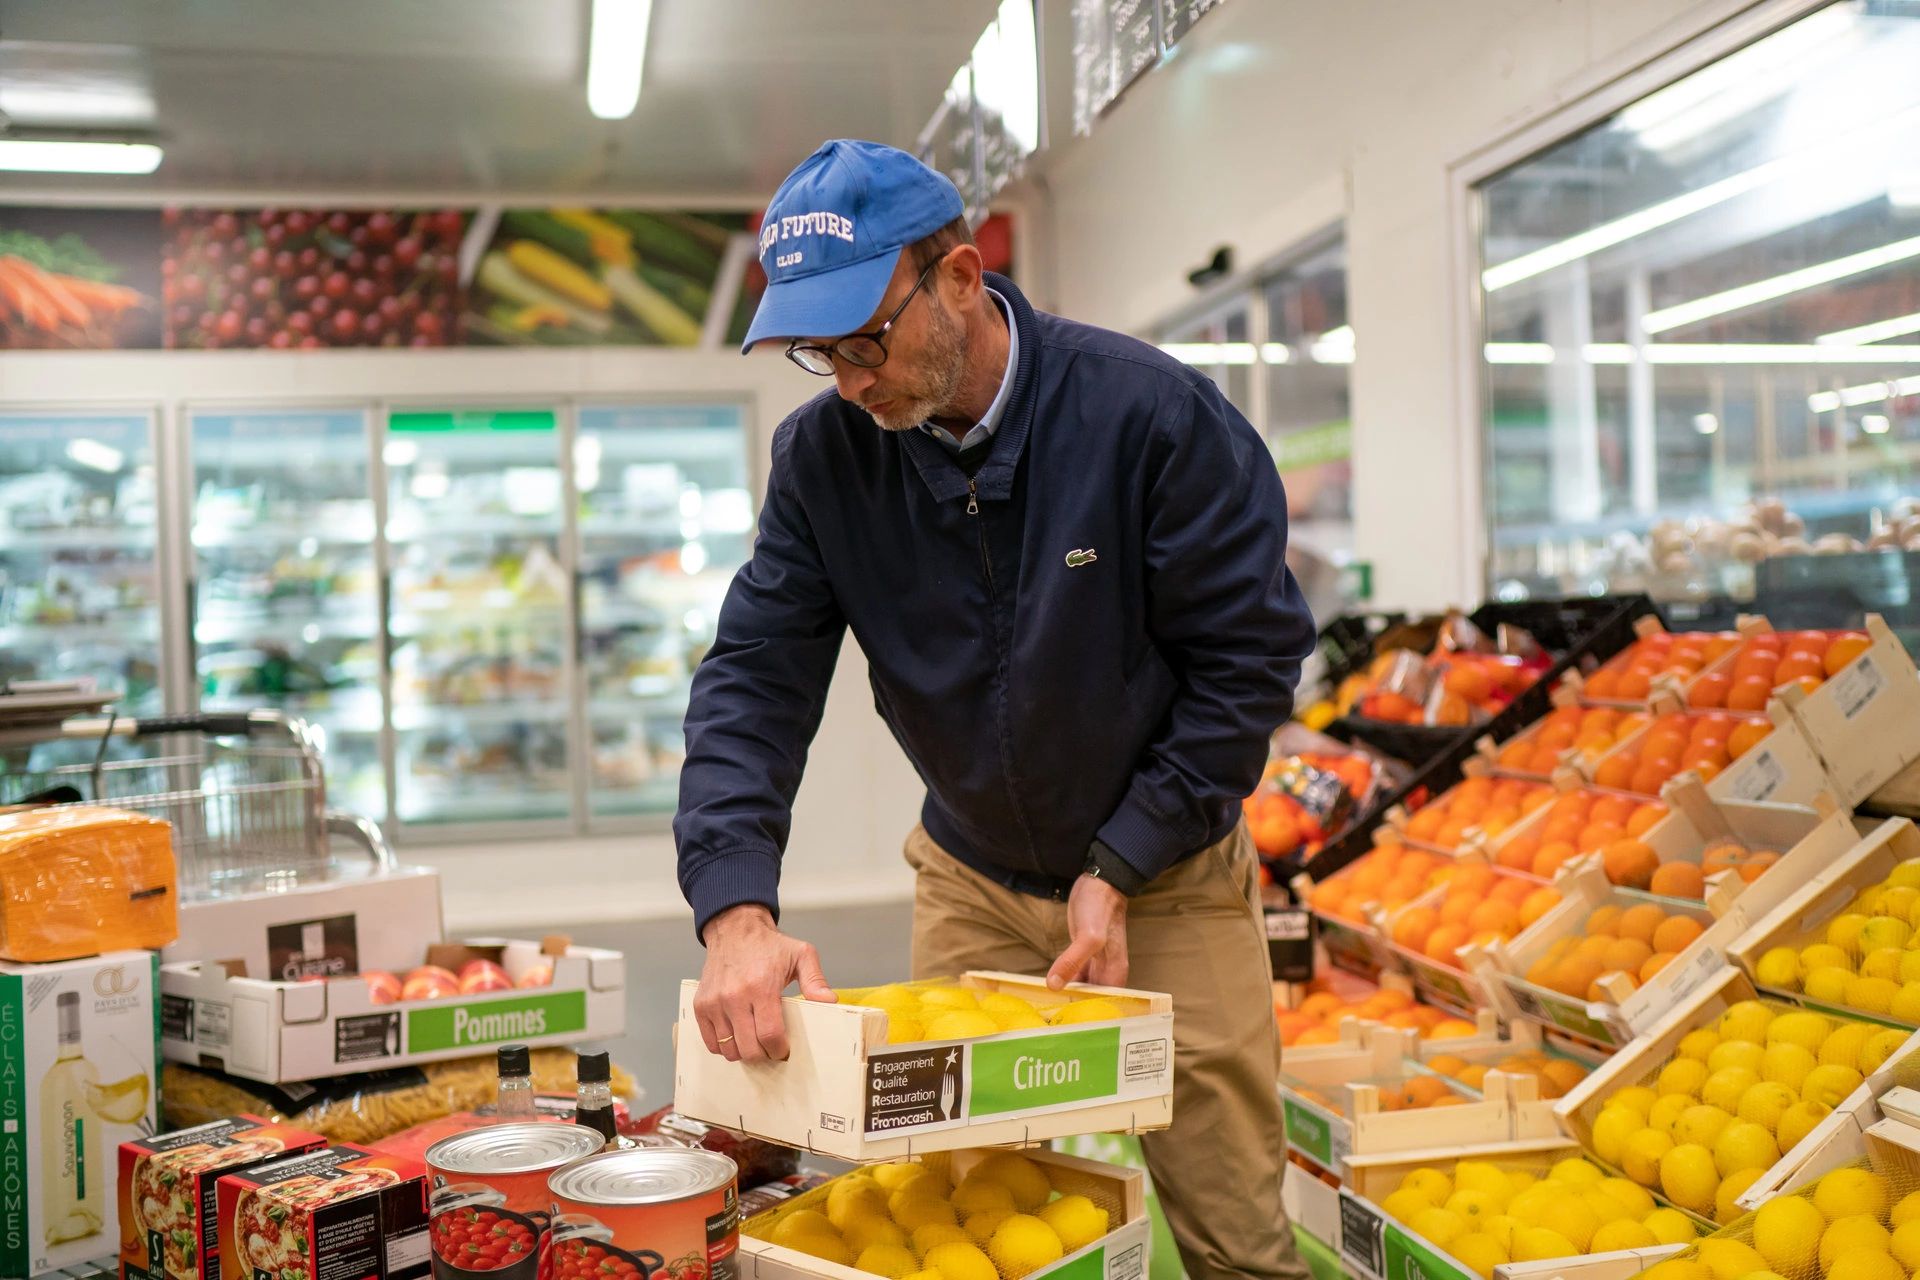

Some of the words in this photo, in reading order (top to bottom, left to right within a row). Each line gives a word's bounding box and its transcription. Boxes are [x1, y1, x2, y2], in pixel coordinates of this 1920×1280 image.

[781, 212, 854, 242] FUTURE
[777, 252, 802, 268] CLUB
[454, 1008, 546, 1044] Pommes
[1, 1002, 18, 1117] ÉCLATS
[874, 1056, 934, 1075] Engagement
[1014, 1054, 1080, 1091] Citron
[872, 1075, 908, 1090] Qualité
[872, 1089, 935, 1107] Restauration
[872, 1110, 934, 1130] Promocash
[63, 1100, 74, 1178] Sauvignon
[4, 1137, 21, 1250] ARÔMES
[707, 1218, 726, 1231] TOMATES
[152, 1234, 159, 1261] S
[1406, 1255, 1431, 1280] Cit
